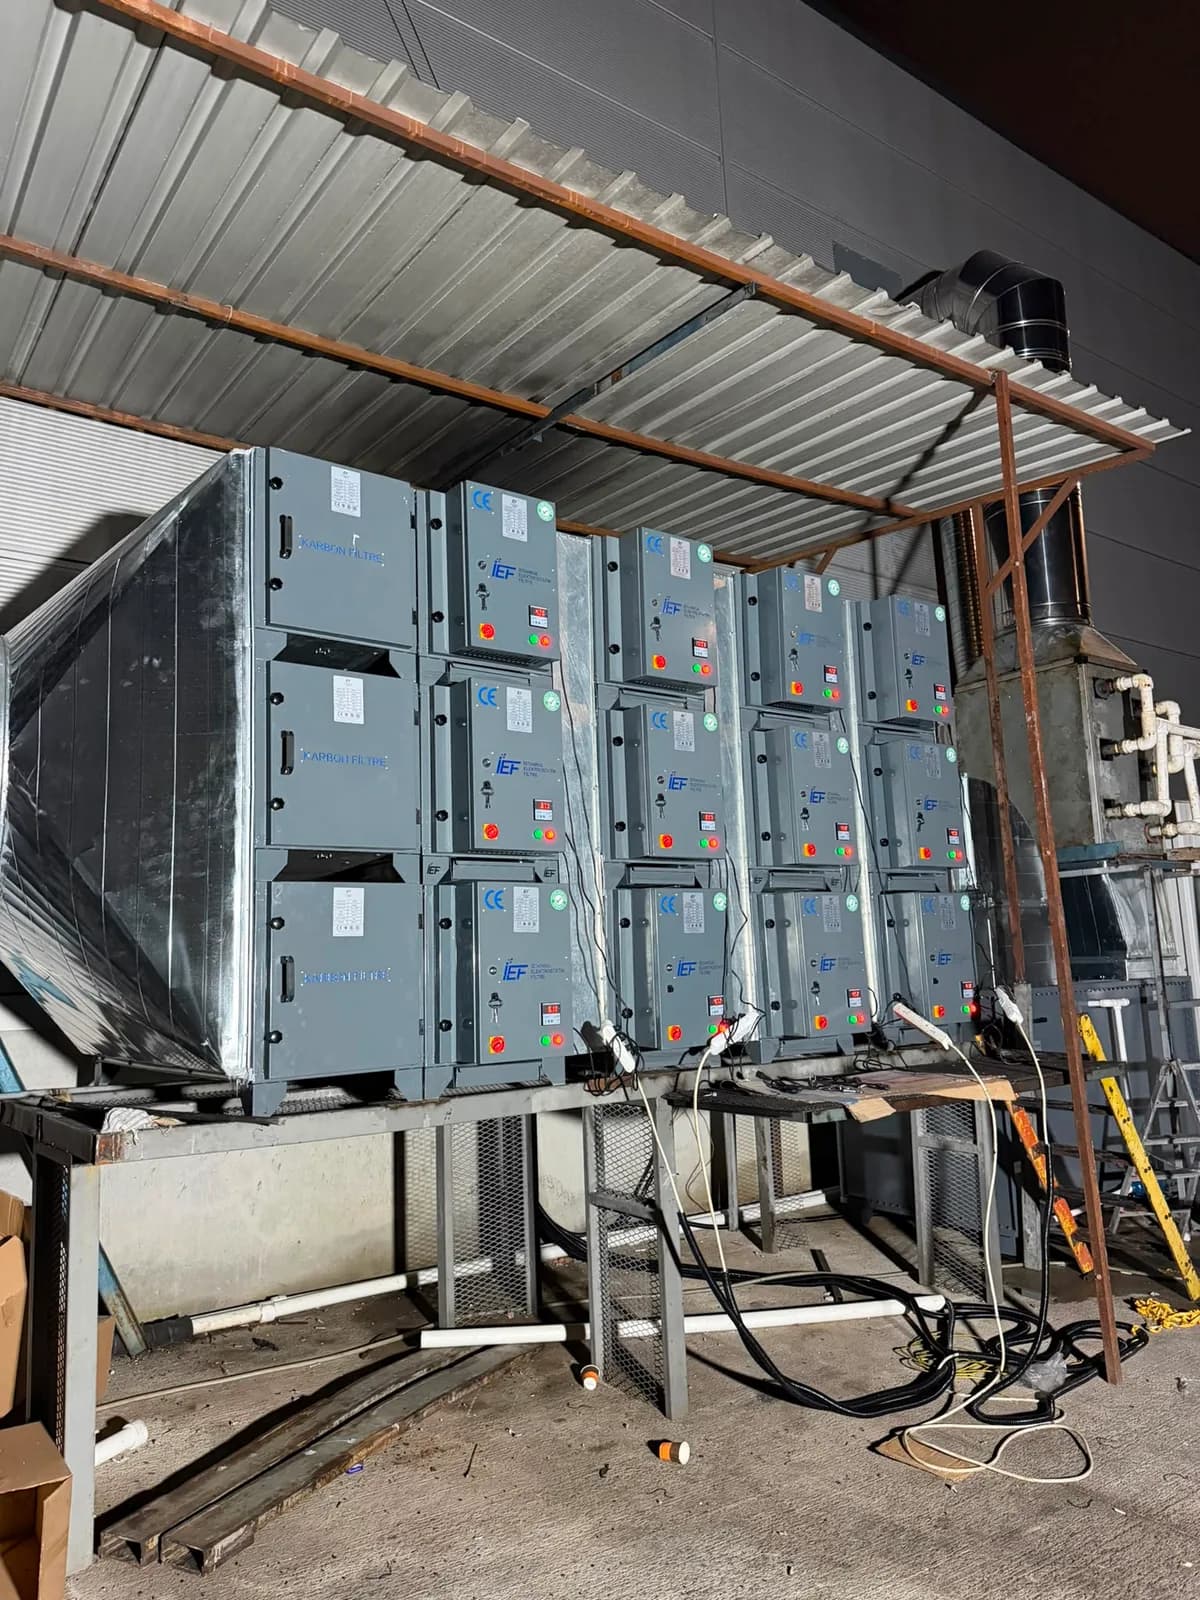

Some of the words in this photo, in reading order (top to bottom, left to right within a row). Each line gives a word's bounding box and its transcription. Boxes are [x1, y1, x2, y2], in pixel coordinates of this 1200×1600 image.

[472, 490, 492, 511] CE
[302, 538, 346, 555] KARBON
[647, 536, 664, 555] CE
[478, 687, 497, 707] CE
[652, 712, 668, 730] CE
[303, 751, 349, 764] KARBON
[484, 889, 504, 910] CE
[660, 896, 676, 913] CE
